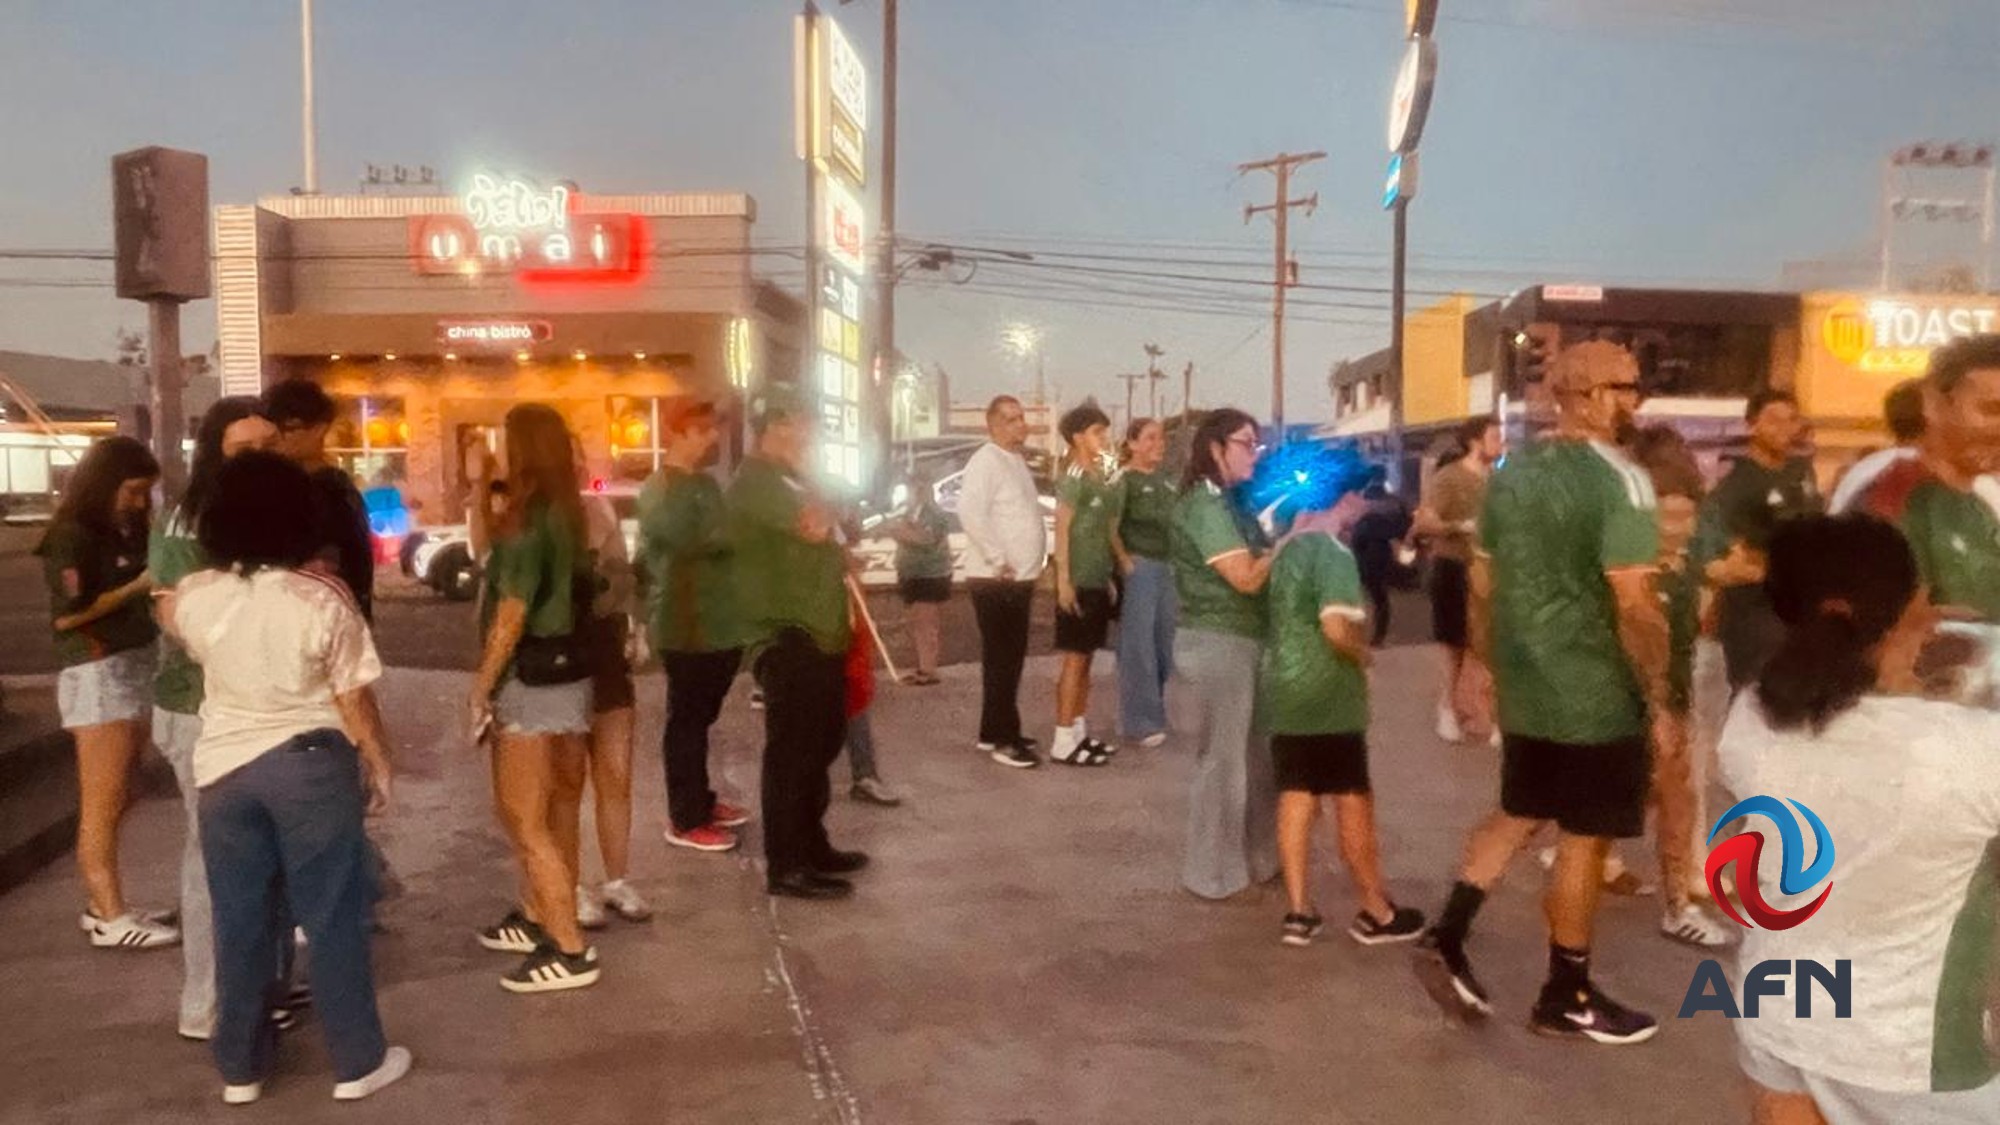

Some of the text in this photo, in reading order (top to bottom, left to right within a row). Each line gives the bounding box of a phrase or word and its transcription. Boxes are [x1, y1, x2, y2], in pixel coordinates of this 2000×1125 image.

[431, 223, 609, 262] umai
[447, 325, 487, 339] china
[1872, 302, 1995, 347] TOAST
